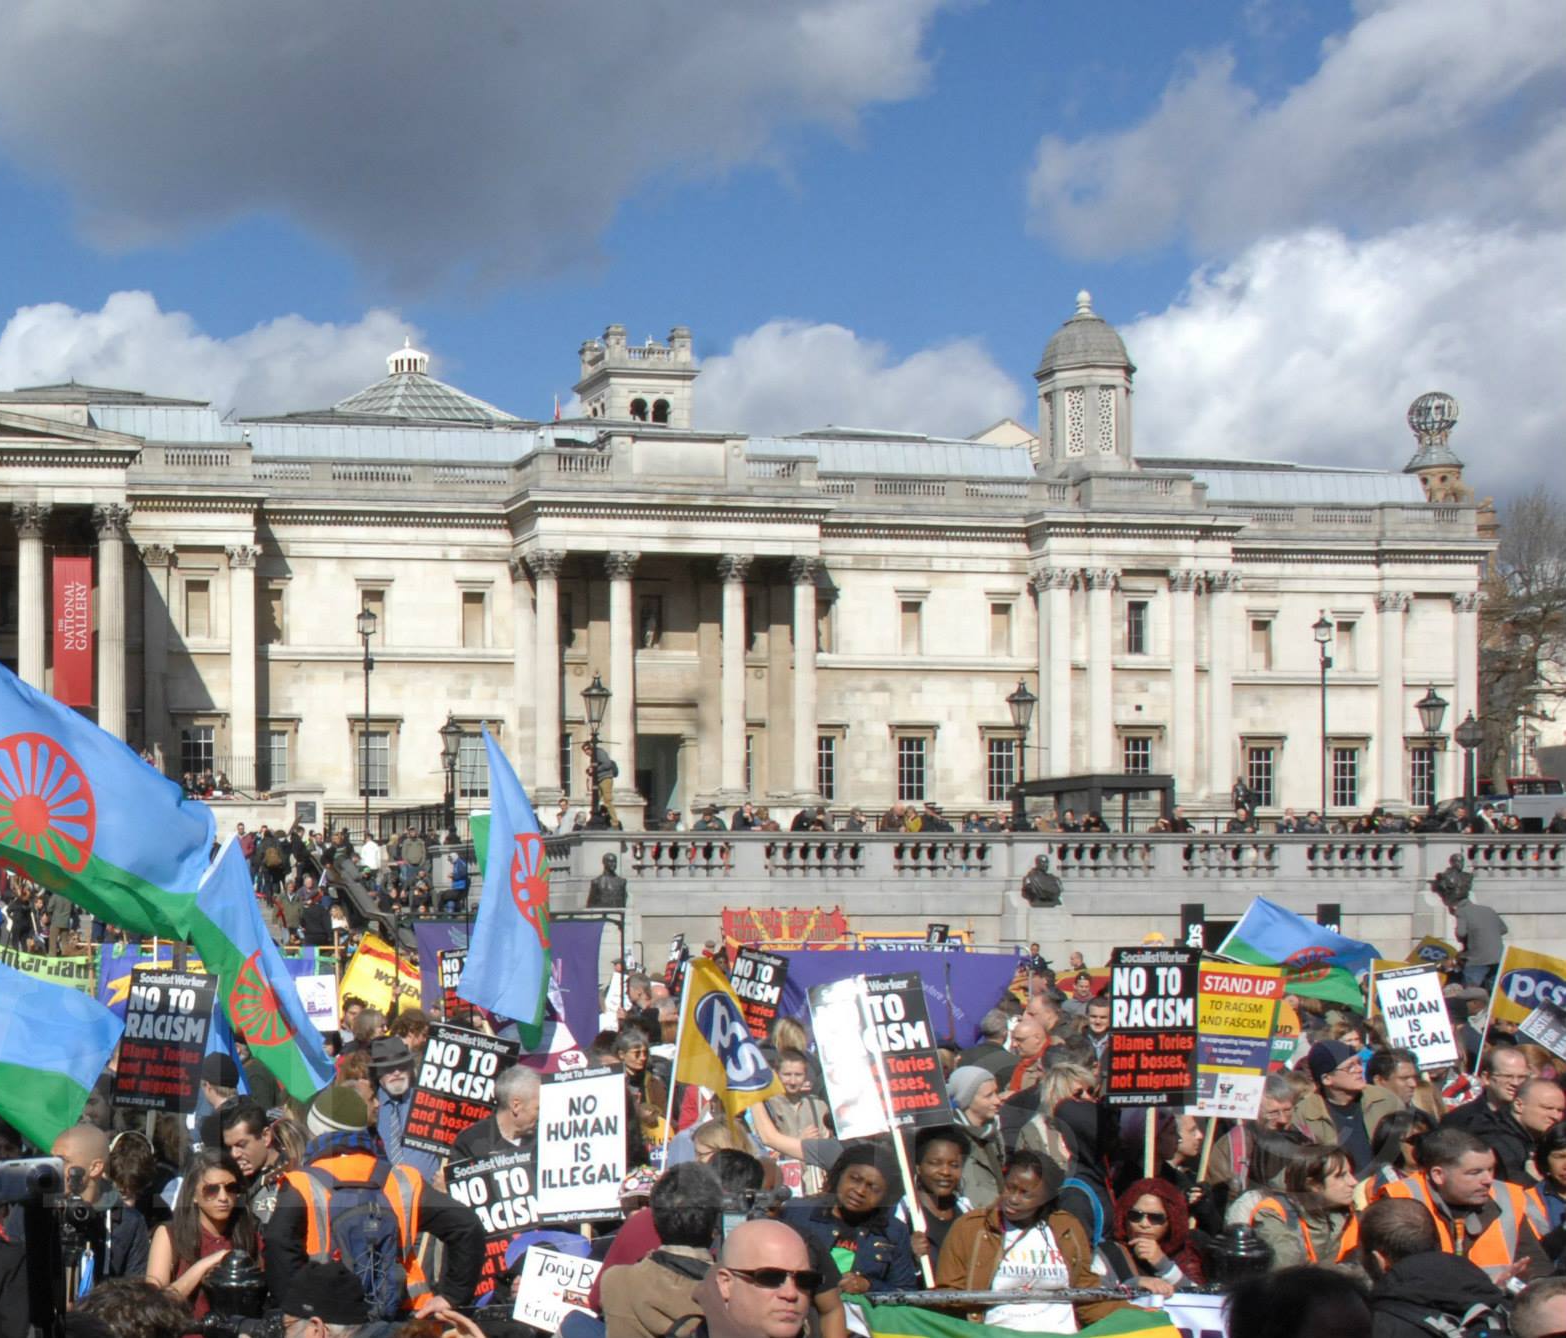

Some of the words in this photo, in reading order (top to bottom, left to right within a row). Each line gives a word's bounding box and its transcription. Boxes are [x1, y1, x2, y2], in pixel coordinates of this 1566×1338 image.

[64, 582, 75, 650] NATIONAL
[75, 582, 87, 650] GALLERY
[733, 913, 832, 926] MANCHESTER
[734, 956, 754, 977] NO
[756, 962, 773, 983] TO
[731, 976, 780, 1004] RACISM
[1113, 967, 1147, 997] NO
[1155, 967, 1182, 996] TO
[1203, 975, 1253, 994] STAND
[1255, 980, 1277, 996] UP
[1507, 973, 1566, 1005] pcs
[128, 985, 162, 1012] NO
[168, 988, 196, 1014] TO
[1396, 987, 1418, 1002] NO
[866, 994, 905, 1022] TO
[1112, 998, 1194, 1028] RACISM
[1209, 1000, 1222, 1011] TO
[1224, 1001, 1263, 1014] RACISM
[1387, 1000, 1439, 1020] HUMAN
[124, 1013, 206, 1043] RACISM
[1200, 1015, 1222, 1026] AND
[1224, 1017, 1267, 1030] FASCISM
[1408, 1019, 1421, 1032] IS
[1113, 1036, 1154, 1051] Blame
[1158, 1034, 1195, 1050] Tories
[425, 1038, 461, 1067] NO
[468, 1049, 498, 1077] TO
[887, 1056, 935, 1073] Tories
[1112, 1055, 1136, 1069] and
[1140, 1055, 1187, 1070] bosses,
[554, 1071, 573, 1082] Right
[573, 1069, 584, 1078] To
[584, 1066, 612, 1077] Remain
[1111, 1073, 1132, 1089] not
[1136, 1073, 1191, 1090] migrants
[415, 1091, 456, 1111] Blame
[460, 1102, 492, 1119] Torie
[568, 1095, 598, 1117] NO
[893, 1091, 941, 1112] grants
[411, 1109, 436, 1123] and
[408, 1122, 430, 1137] not
[547, 1115, 618, 1142] HUMAN
[574, 1142, 591, 1163] IS
[542, 1163, 622, 1189] ILLEGAL
[449, 1177, 489, 1208] NO
[493, 1167, 530, 1197] TO
[534, 1251, 575, 1287] Tony
